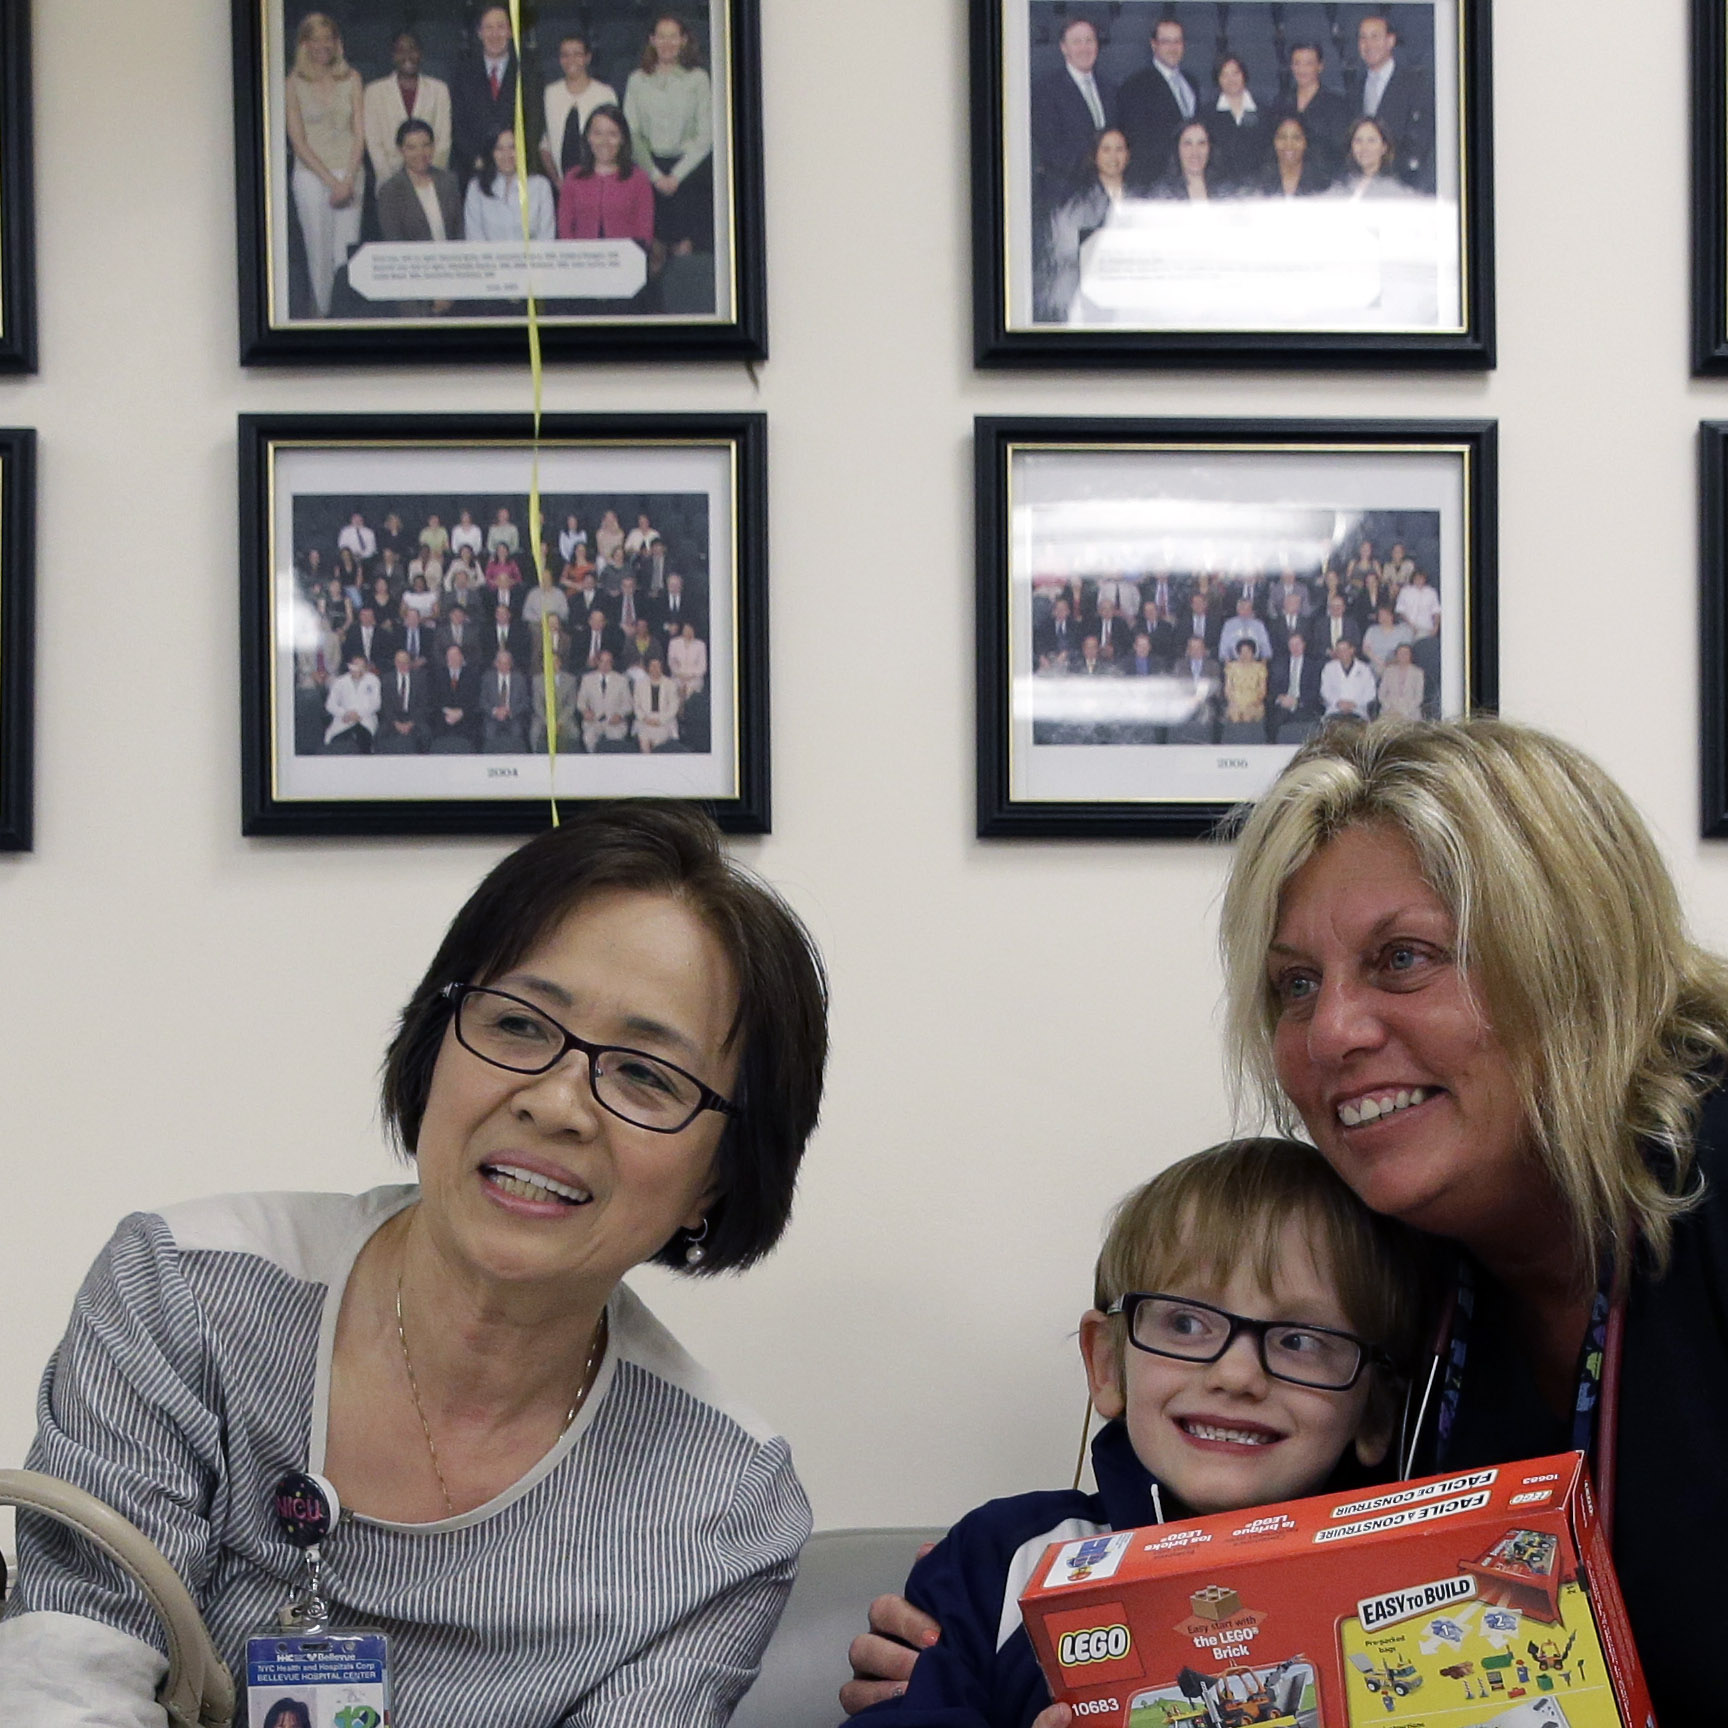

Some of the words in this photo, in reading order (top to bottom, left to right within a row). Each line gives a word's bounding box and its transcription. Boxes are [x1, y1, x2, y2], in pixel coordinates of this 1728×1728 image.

[1417, 1485, 1434, 1496] DE
[1336, 1493, 1414, 1516] CONSTRUIR
[1418, 1494, 1485, 1519] FACILE
[1319, 1514, 1404, 1540] CONSTRUIRE
[1362, 1594, 1406, 1626] EASY
[1424, 1579, 1470, 1606] BUILD
[1187, 1625, 1208, 1634] Easy
[1211, 1621, 1232, 1630] start
[1235, 1615, 1257, 1627] with
[1441, 1624, 1449, 1636] 1
[1496, 1615, 1505, 1628] 2
[1060, 1625, 1129, 1665] LEGO
[1193, 1635, 1218, 1648] the
[1212, 1644, 1250, 1660] Brick
[258, 1664, 275, 1673] NYC
[277, 1663, 301, 1672] Health
[303, 1663, 317, 1671] and
[318, 1662, 354, 1672] Hospitals
[355, 1661, 375, 1671] Corp
[257, 1673, 300, 1682] BELLEVUE
[301, 1672, 340, 1681] HOSPITAL
[343, 1671, 376, 1680] CENTER
[1072, 1697, 1120, 1717] 10683
